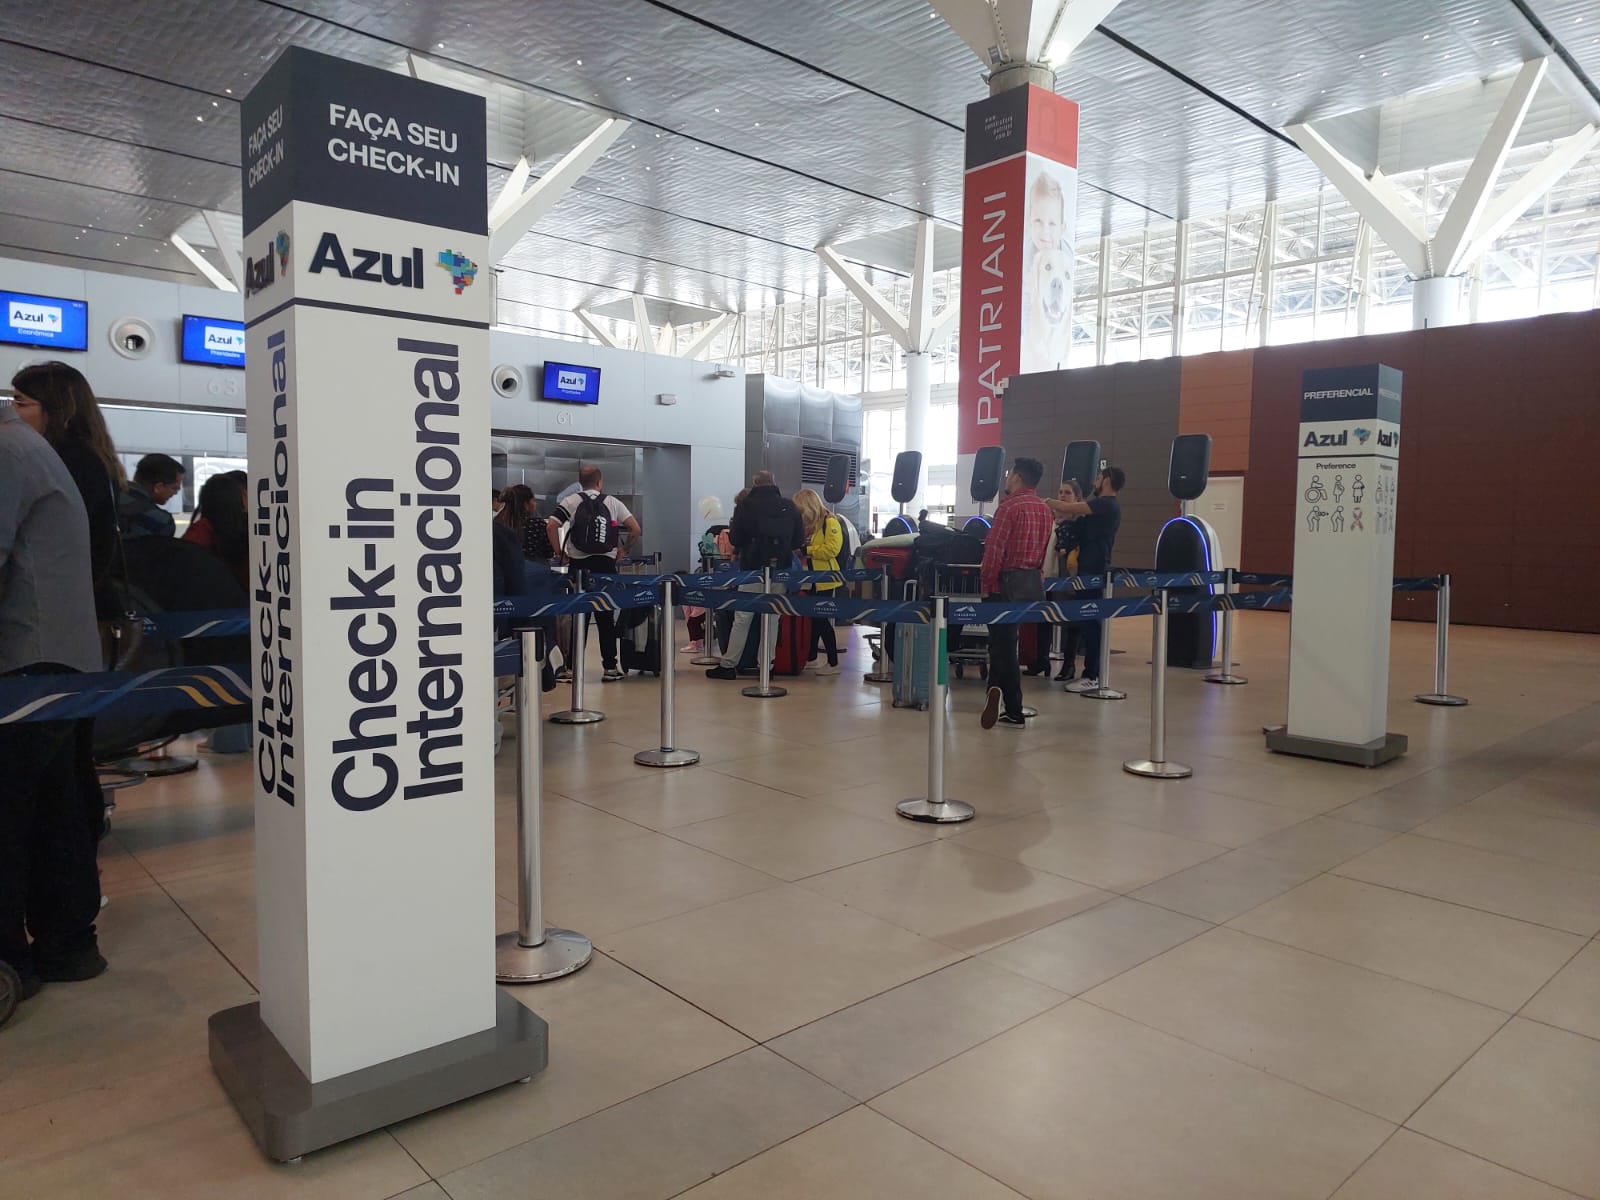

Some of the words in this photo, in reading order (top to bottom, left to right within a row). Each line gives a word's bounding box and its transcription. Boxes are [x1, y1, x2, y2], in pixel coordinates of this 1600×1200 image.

[249, 121, 267, 157] FAÇA
[267, 104, 283, 138] SEU
[329, 103, 402, 141] FAÇA
[407, 122, 458, 153] SEU
[249, 138, 285, 188] CHECK-IN
[328, 138, 460, 187] CHECK-IN
[245, 241, 275, 299] Azul
[308, 231, 424, 289] Azul
[13, 310, 43, 323] Azul
[977, 191, 1006, 425] PATRIANI
[208, 334, 232, 345] Azul
[560, 376, 577, 385] Azul
[1304, 388, 1373, 400] PREFERENCIAL
[1304, 430, 1348, 448] Azul
[1377, 429, 1392, 448] Azul
[1316, 462, 1357, 470] Preference
[267, 329, 295, 807] Internacional
[397, 337, 464, 801] Internacional
[254, 478, 276, 794] Check-in
[329, 477, 399, 812] Check-in
